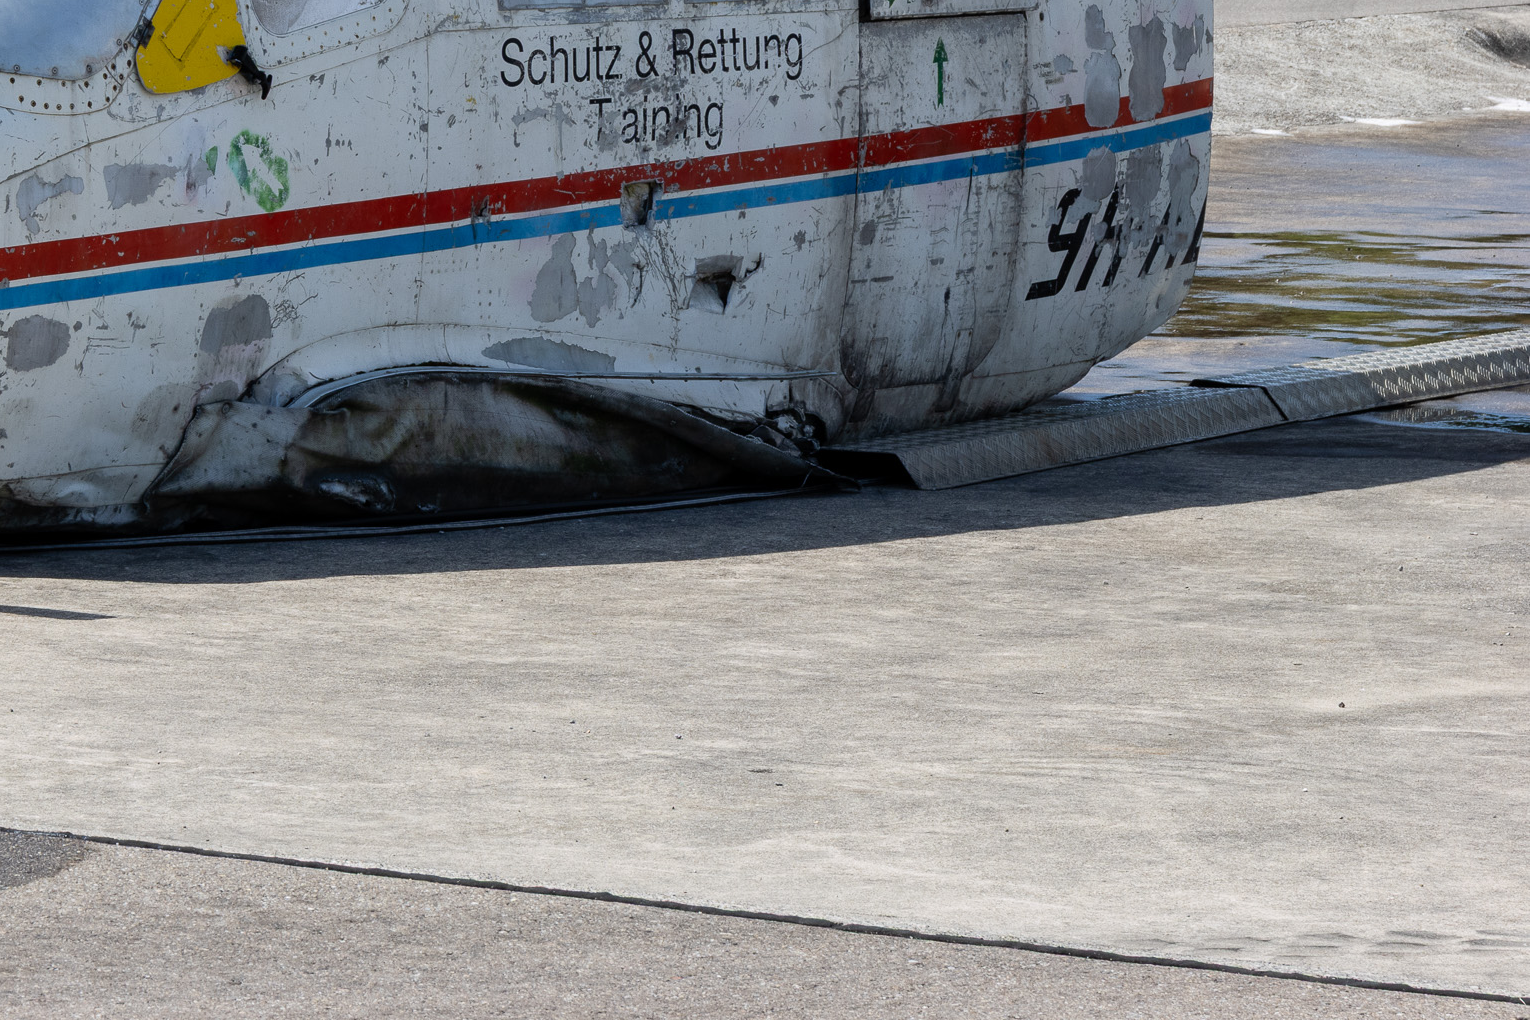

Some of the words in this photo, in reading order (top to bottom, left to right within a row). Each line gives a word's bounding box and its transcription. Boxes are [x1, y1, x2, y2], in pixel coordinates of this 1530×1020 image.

[500, 36, 623, 88] Schutz
[635, 30, 660, 79] &
[672, 27, 803, 81] Rettung
[589, 93, 724, 151] Taining
